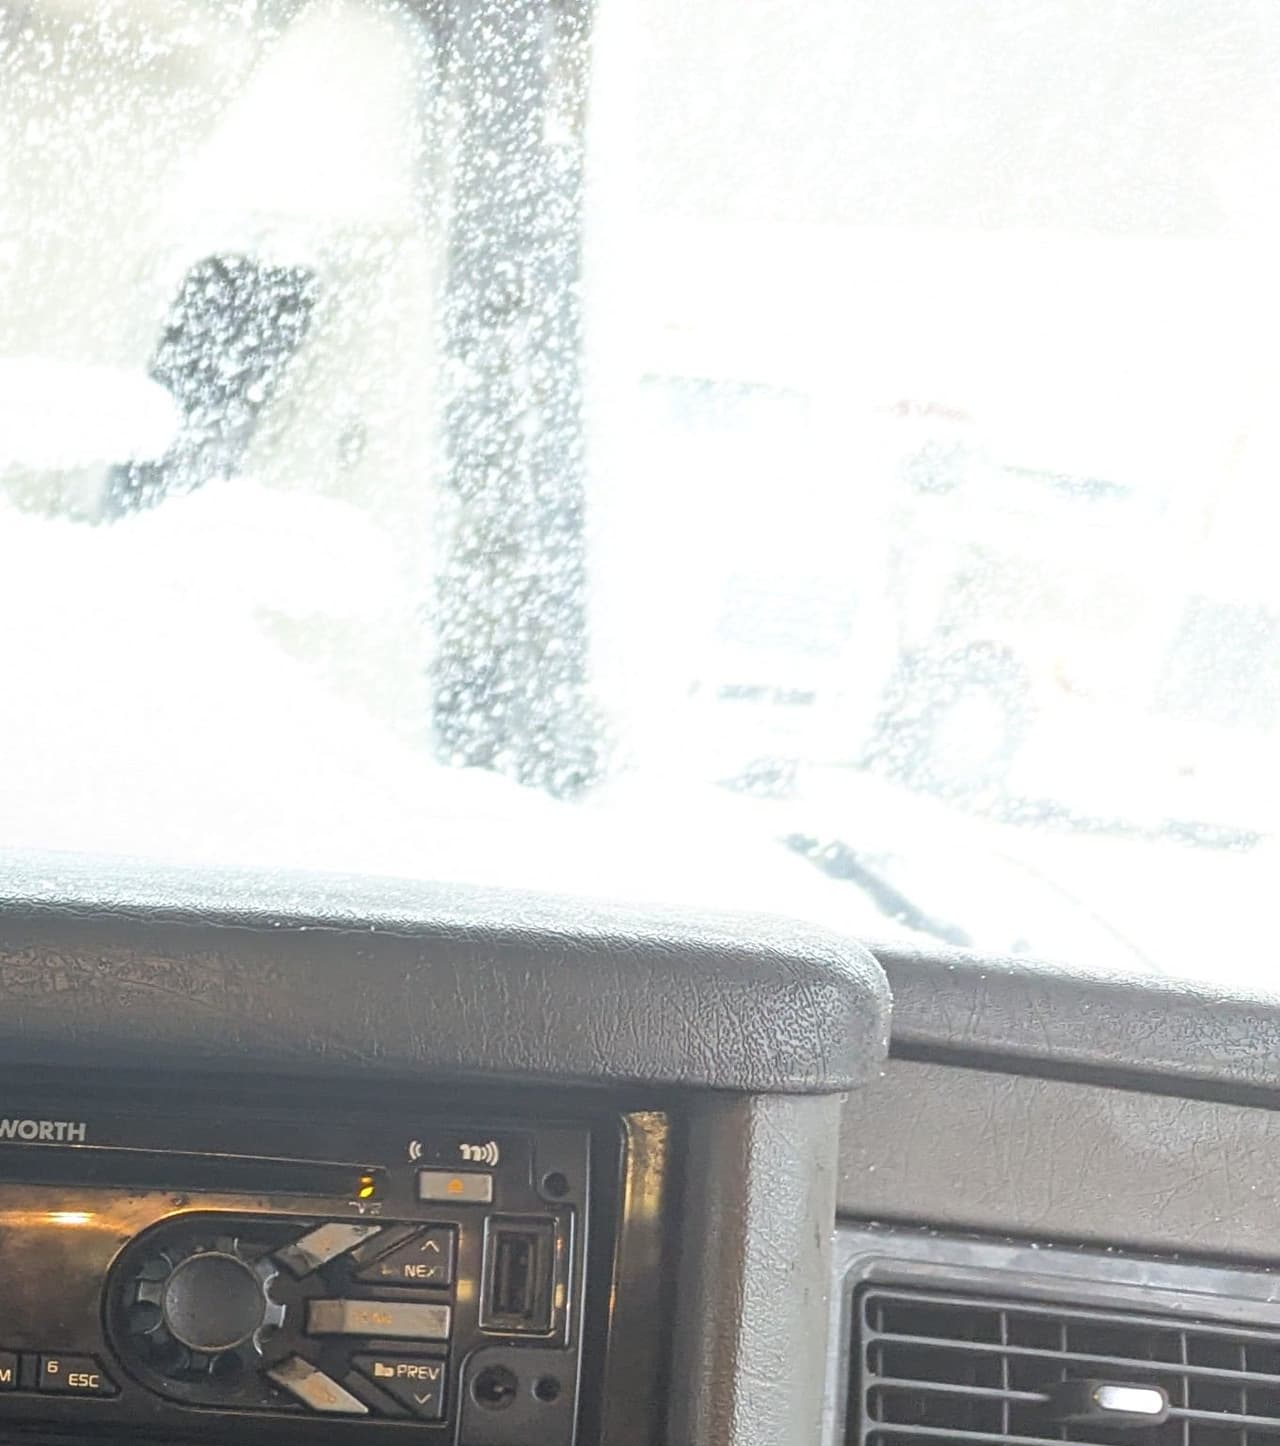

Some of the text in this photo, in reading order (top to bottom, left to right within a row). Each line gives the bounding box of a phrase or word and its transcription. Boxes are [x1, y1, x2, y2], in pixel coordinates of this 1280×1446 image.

[404, 1264, 444, 1278] NEX
[47, 1361, 100, 1388] 6 ESC
[397, 1364, 439, 1381] PREV
